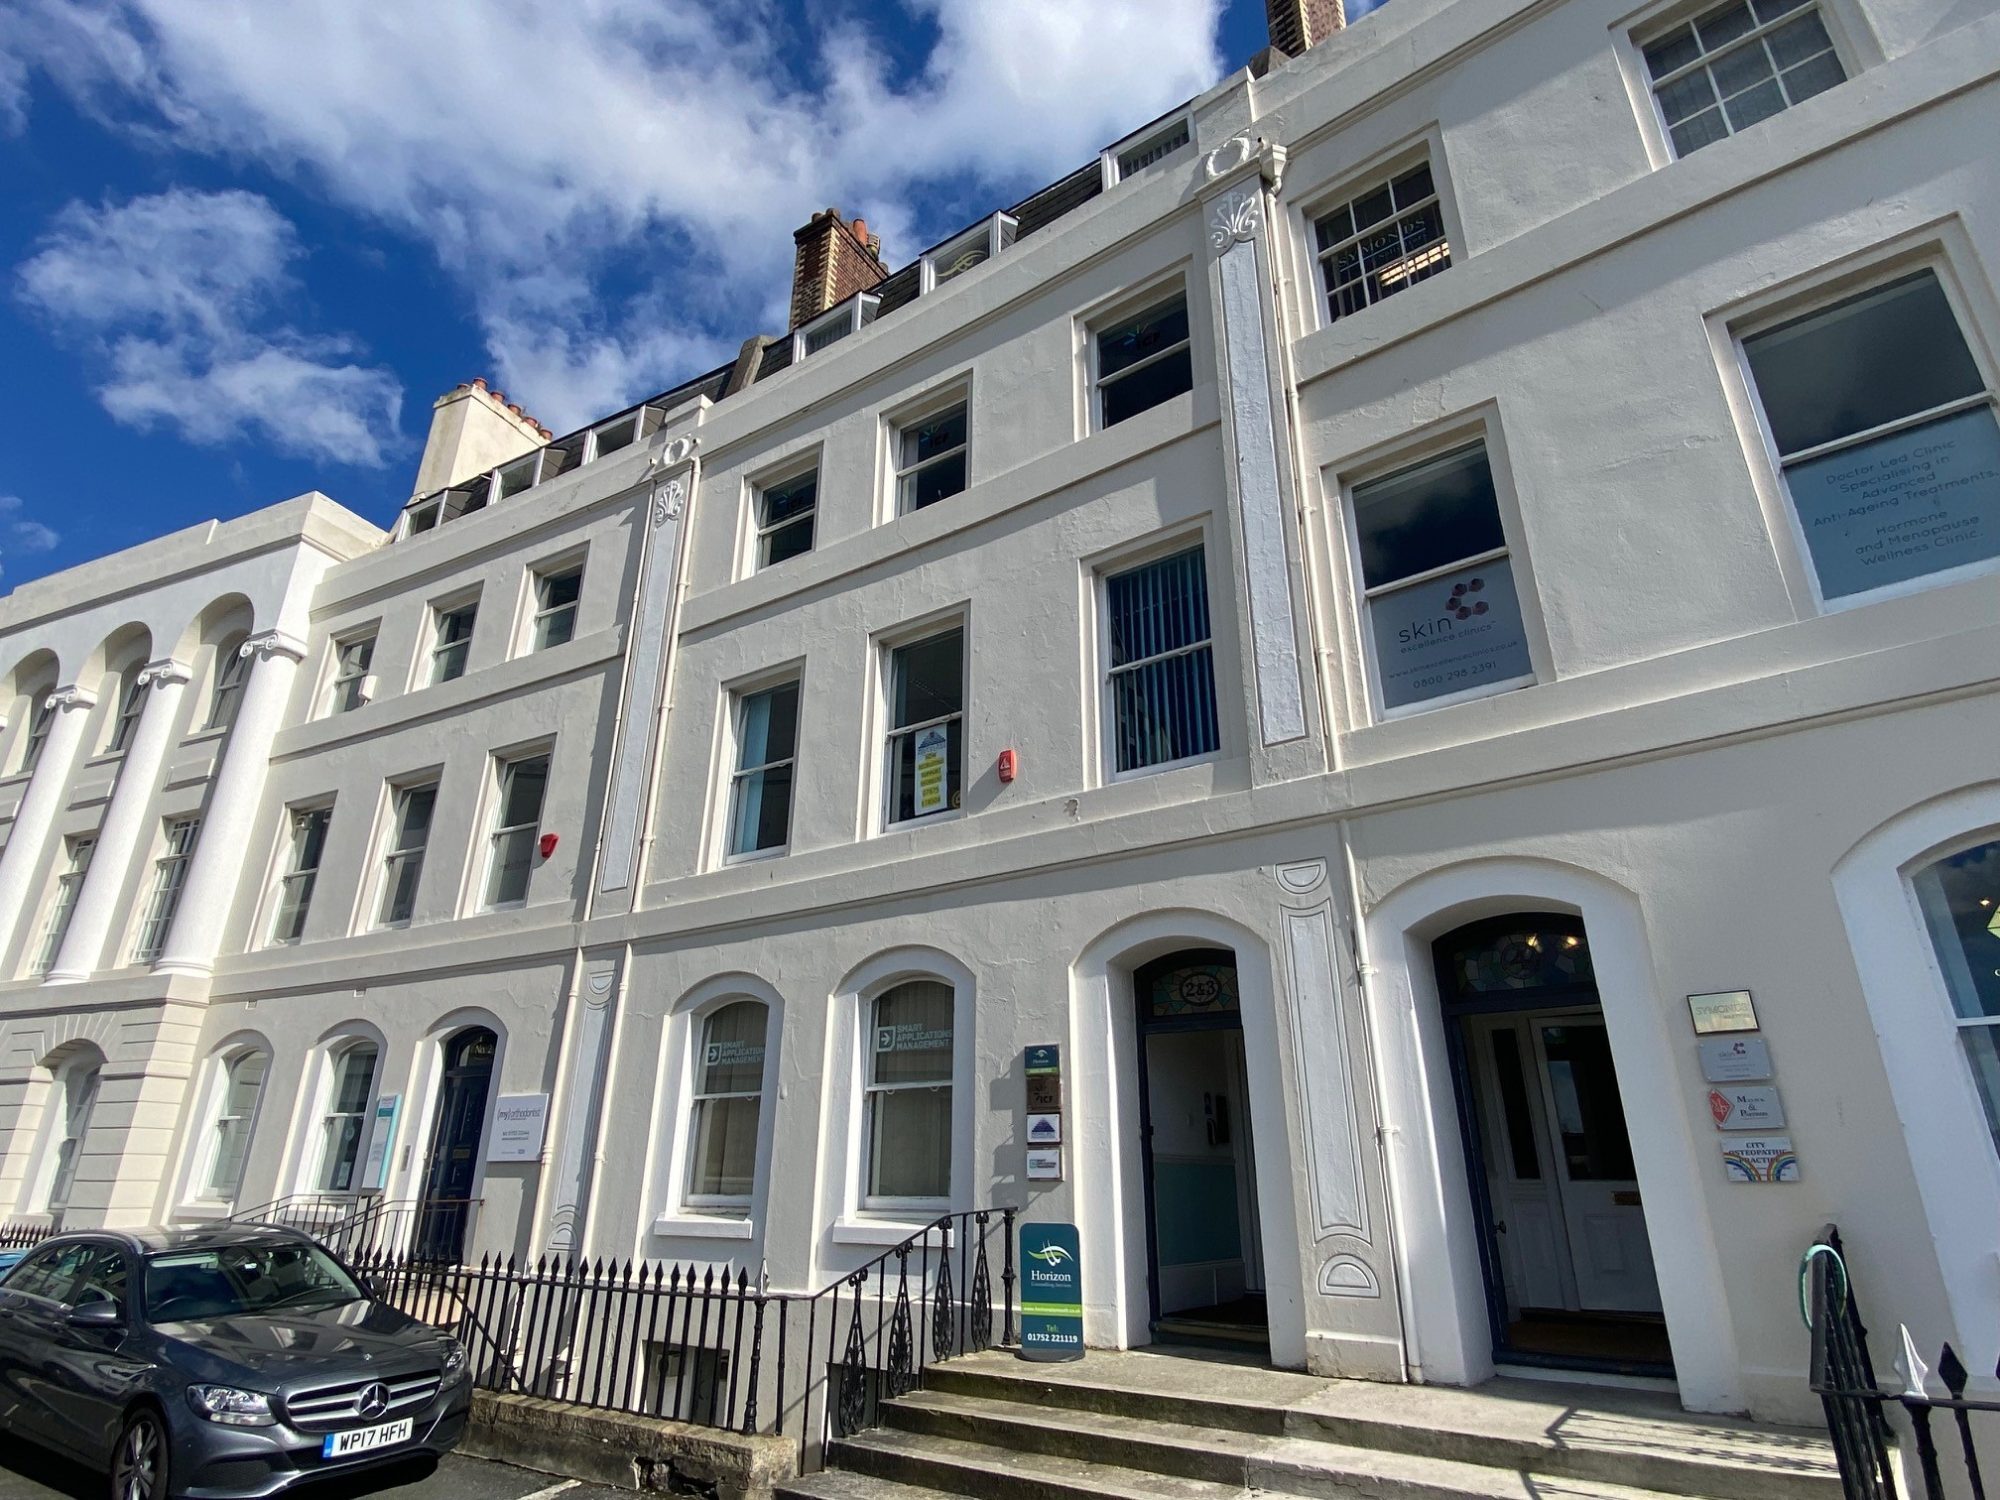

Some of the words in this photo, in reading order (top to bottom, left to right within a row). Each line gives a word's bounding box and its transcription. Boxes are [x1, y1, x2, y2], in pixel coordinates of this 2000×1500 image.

[1825, 464, 1874, 486] Doctor
[1880, 454, 1908, 469] Led
[1912, 439, 1957, 460] Clinic
[1839, 461, 1931, 494] Specialising
[1935, 455, 1950, 465] in
[1862, 471, 1937, 500] Advanced
[1813, 497, 1900, 527] Anti-Ageing
[1875, 511, 1948, 536] Hormone
[1855, 539, 1884, 555] and
[1888, 515, 1980, 546] Menopause
[1860, 543, 1930, 566] Wellness
[1934, 529, 1984, 548] Clinic.
[1399, 617, 1452, 643] skin
[1400, 634, 1456, 654] excellence
[1413, 674, 1443, 689] 0800
[1447, 669, 1468, 681] 298
[1472, 661, 1497, 675] 2391
[896, 1023, 923, 1033] SMART
[896, 1029, 952, 1042] APPLICATIONS
[722, 1040, 745, 1049] SMART
[722, 1047, 765, 1057] APPLICATION
[896, 1038, 951, 1051] MANAGEMENT
[1031, 1270, 1072, 1282] Horizon
[1027, 1333, 1050, 1342] 01752
[1051, 1334, 1078, 1343] 221119
[339, 1430, 376, 1452] WP17
[378, 1423, 408, 1444] HFH
